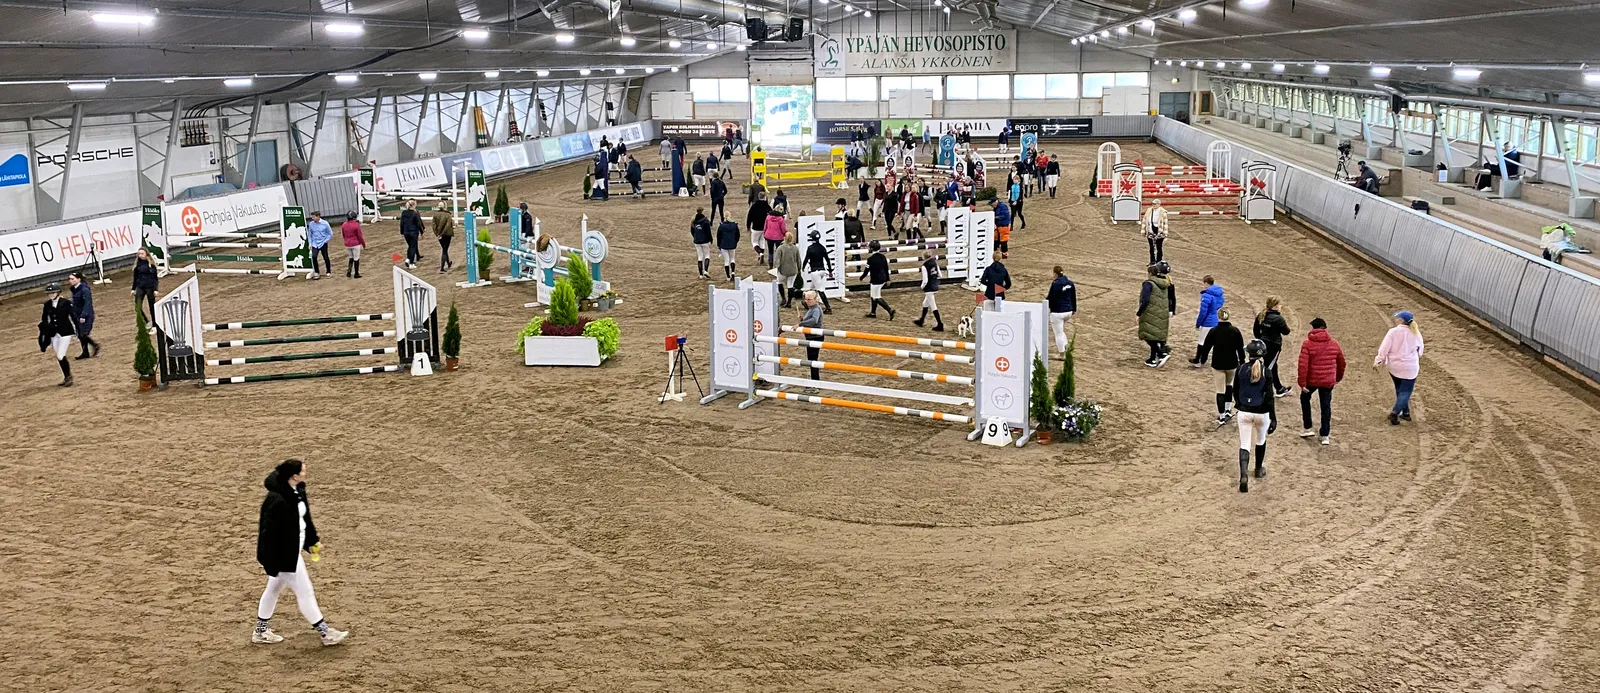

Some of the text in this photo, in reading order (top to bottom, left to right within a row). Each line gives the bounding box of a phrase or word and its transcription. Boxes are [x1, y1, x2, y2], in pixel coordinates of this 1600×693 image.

[846, 34, 1006, 54] YPÄJÄN HEVOSOPISTO
[861, 57, 916, 69] ALANSA
[921, 55, 993, 68] YKKÖNEN
[395, 164, 435, 188] LEGIMIA
[202, 202, 267, 226] Pohjola Vakuutus
[27, 241, 54, 264] TO
[58, 225, 134, 259] HELSINKI
[417, 357, 424, 369] 1
[988, 422, 1008, 437] 9 9
